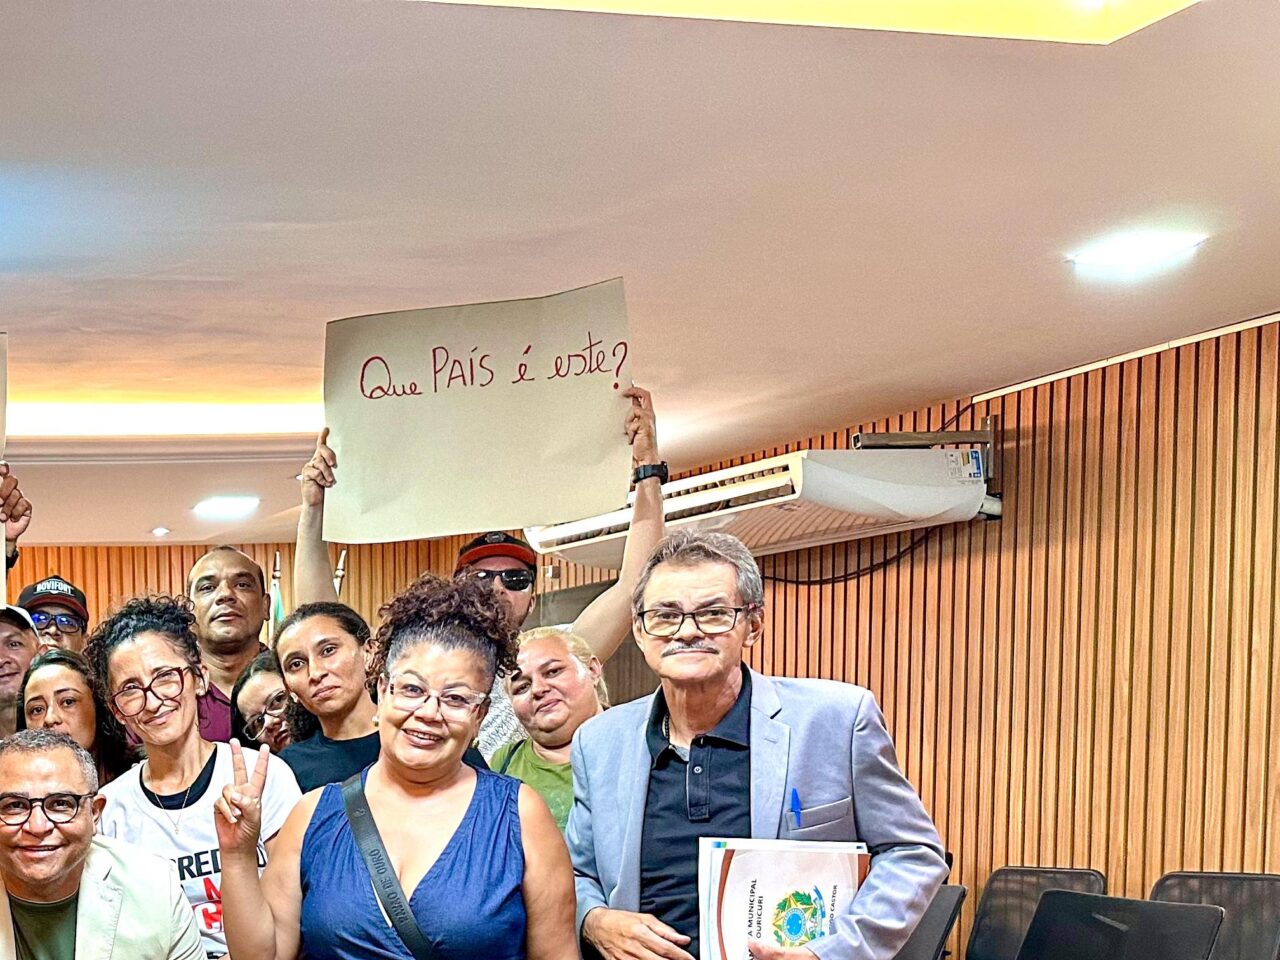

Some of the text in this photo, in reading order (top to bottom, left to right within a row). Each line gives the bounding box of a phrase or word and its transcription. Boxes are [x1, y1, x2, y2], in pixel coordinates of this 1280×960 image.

[360, 331, 629, 400] Que PAÍS é este?
[747, 879, 758, 928] MUNICIPAL
[756, 895, 764, 939] OURICURI
[830, 884, 838, 912] CASTOR
